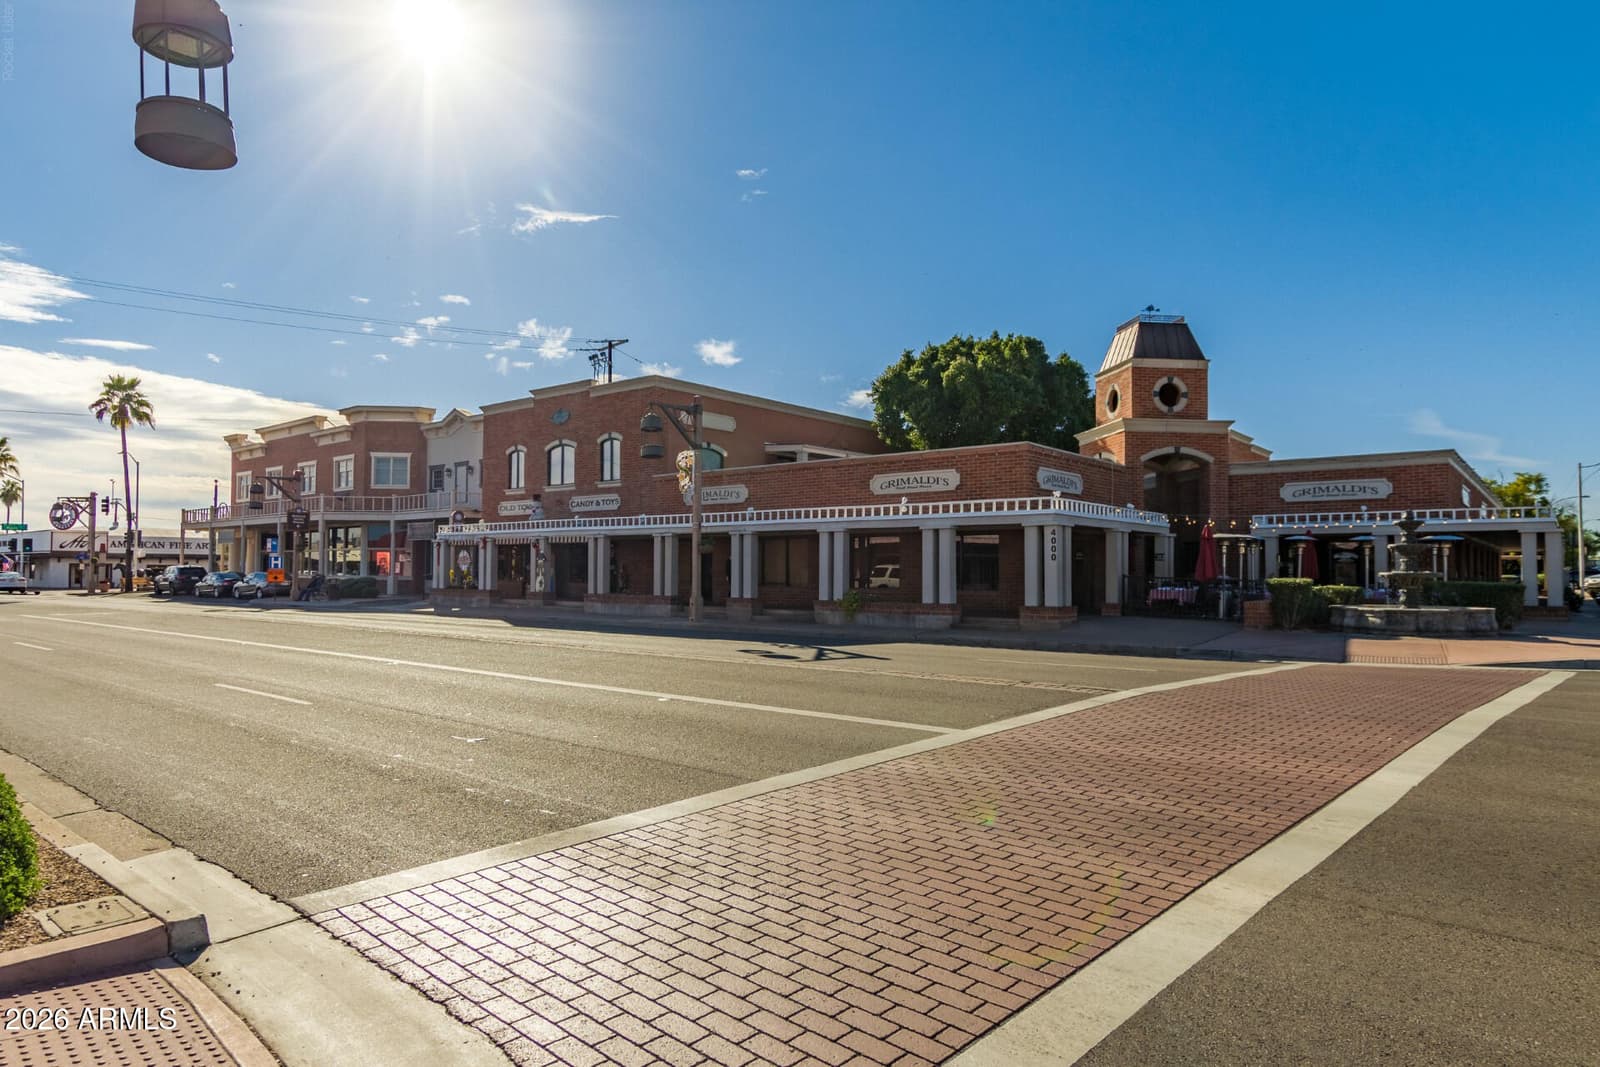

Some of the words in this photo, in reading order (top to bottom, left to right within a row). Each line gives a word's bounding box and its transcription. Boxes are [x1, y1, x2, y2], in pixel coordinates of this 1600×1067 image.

[880, 476, 950, 490] GRIMALDI'S
[1292, 485, 1379, 498] GRIMALDI'S
[570, 500, 593, 508] CANDY
[271, 557, 282, 569] H
